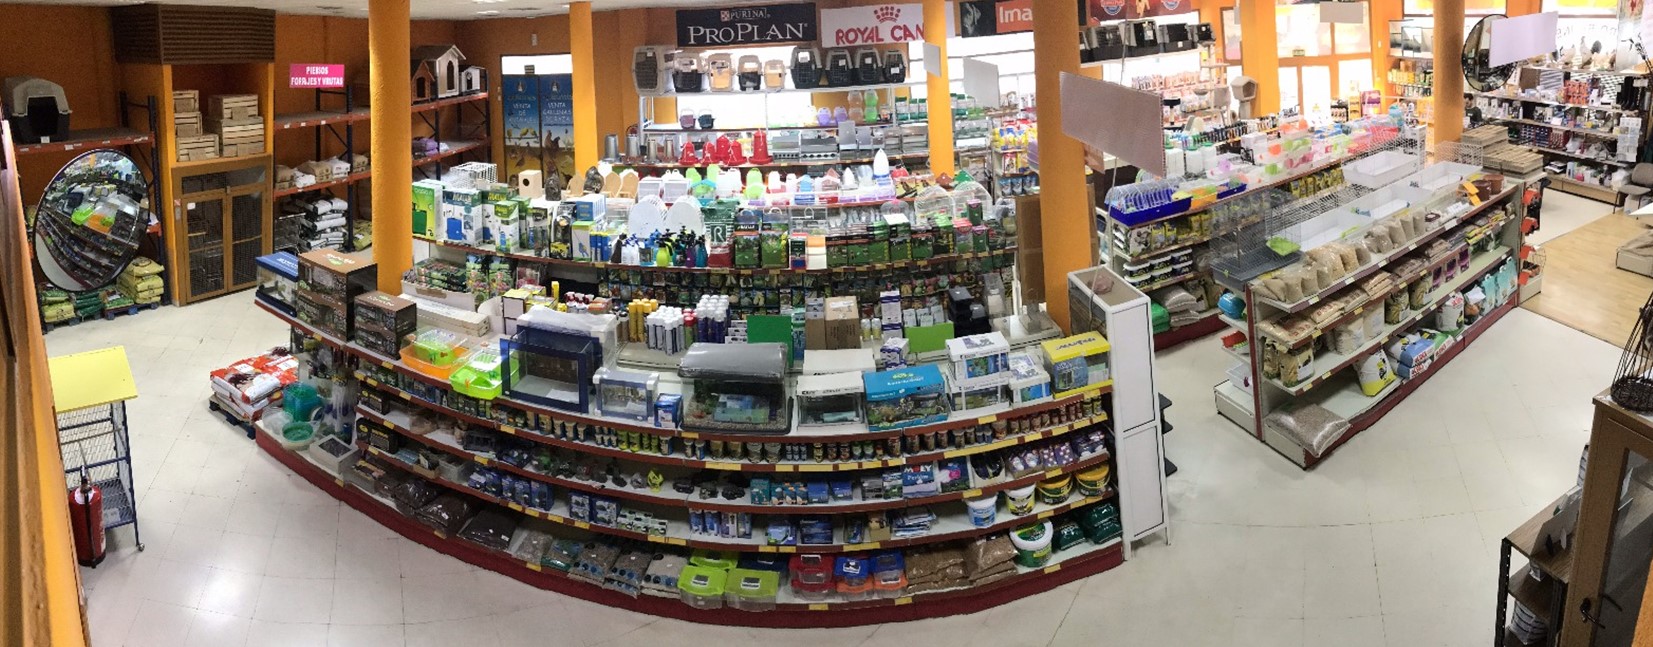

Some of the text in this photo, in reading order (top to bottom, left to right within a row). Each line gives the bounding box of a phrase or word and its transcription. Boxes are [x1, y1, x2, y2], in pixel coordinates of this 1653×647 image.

[730, 9, 766, 19] PURINA
[835, 26, 884, 45] ROYAL
[317, 77, 322, 86] Y
